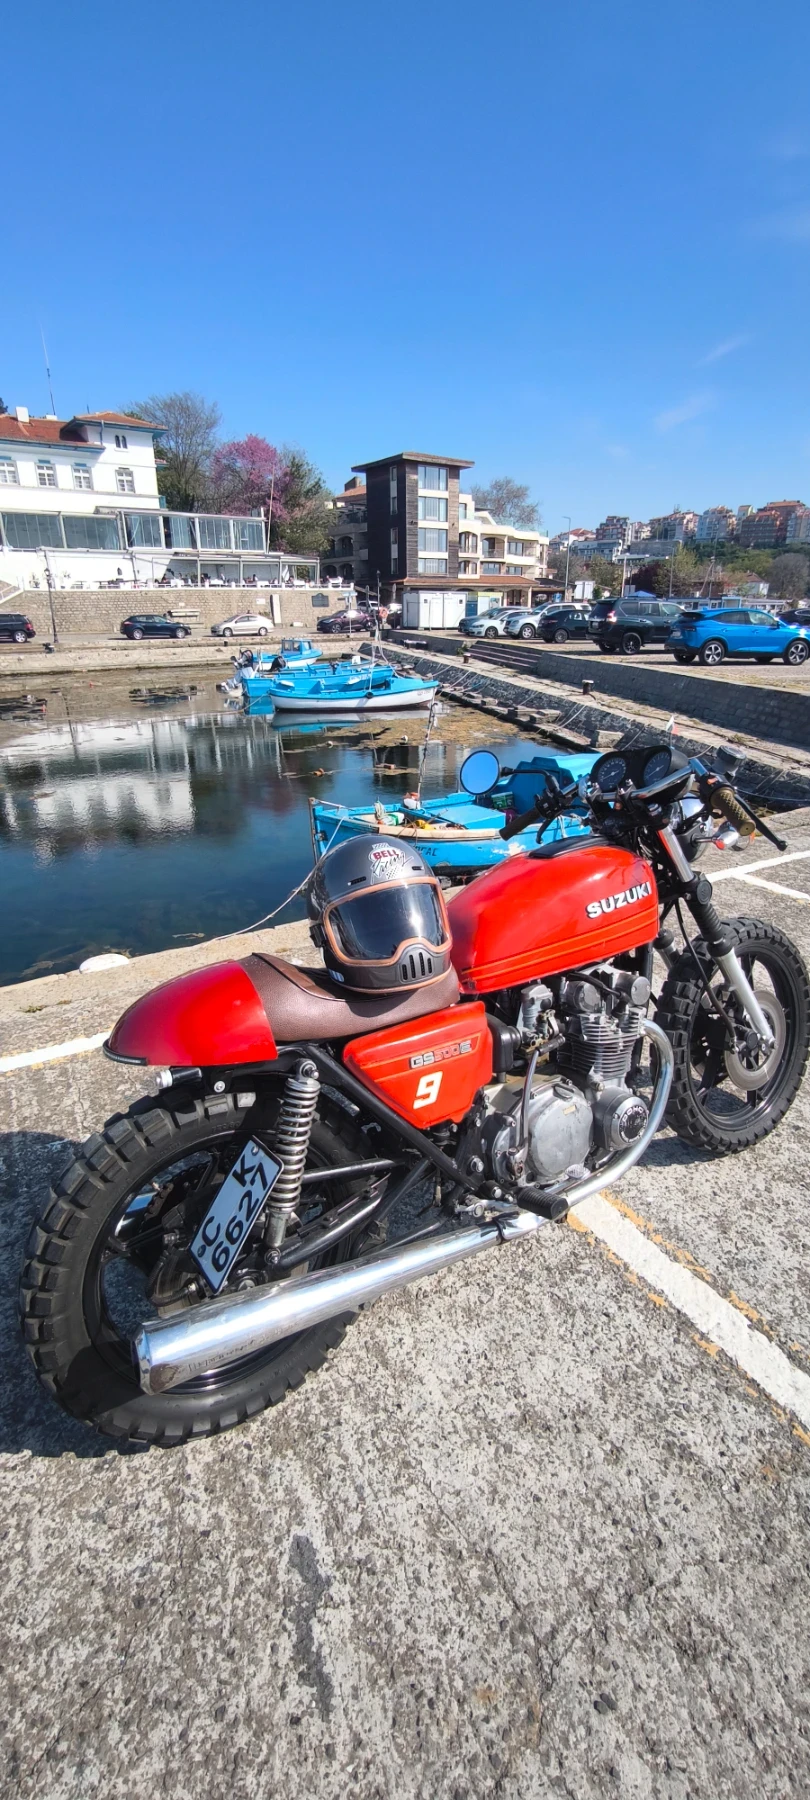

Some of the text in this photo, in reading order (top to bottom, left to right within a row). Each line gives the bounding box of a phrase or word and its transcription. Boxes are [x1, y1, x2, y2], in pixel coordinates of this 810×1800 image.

[373, 849, 399, 860] BELL
[585, 881, 652, 919] SUZUKI
[409, 1040, 472, 1069] GS500E
[413, 1071, 443, 1110] 9
[202, 1154, 256, 1247] C K
[212, 1162, 268, 1273] 6627
